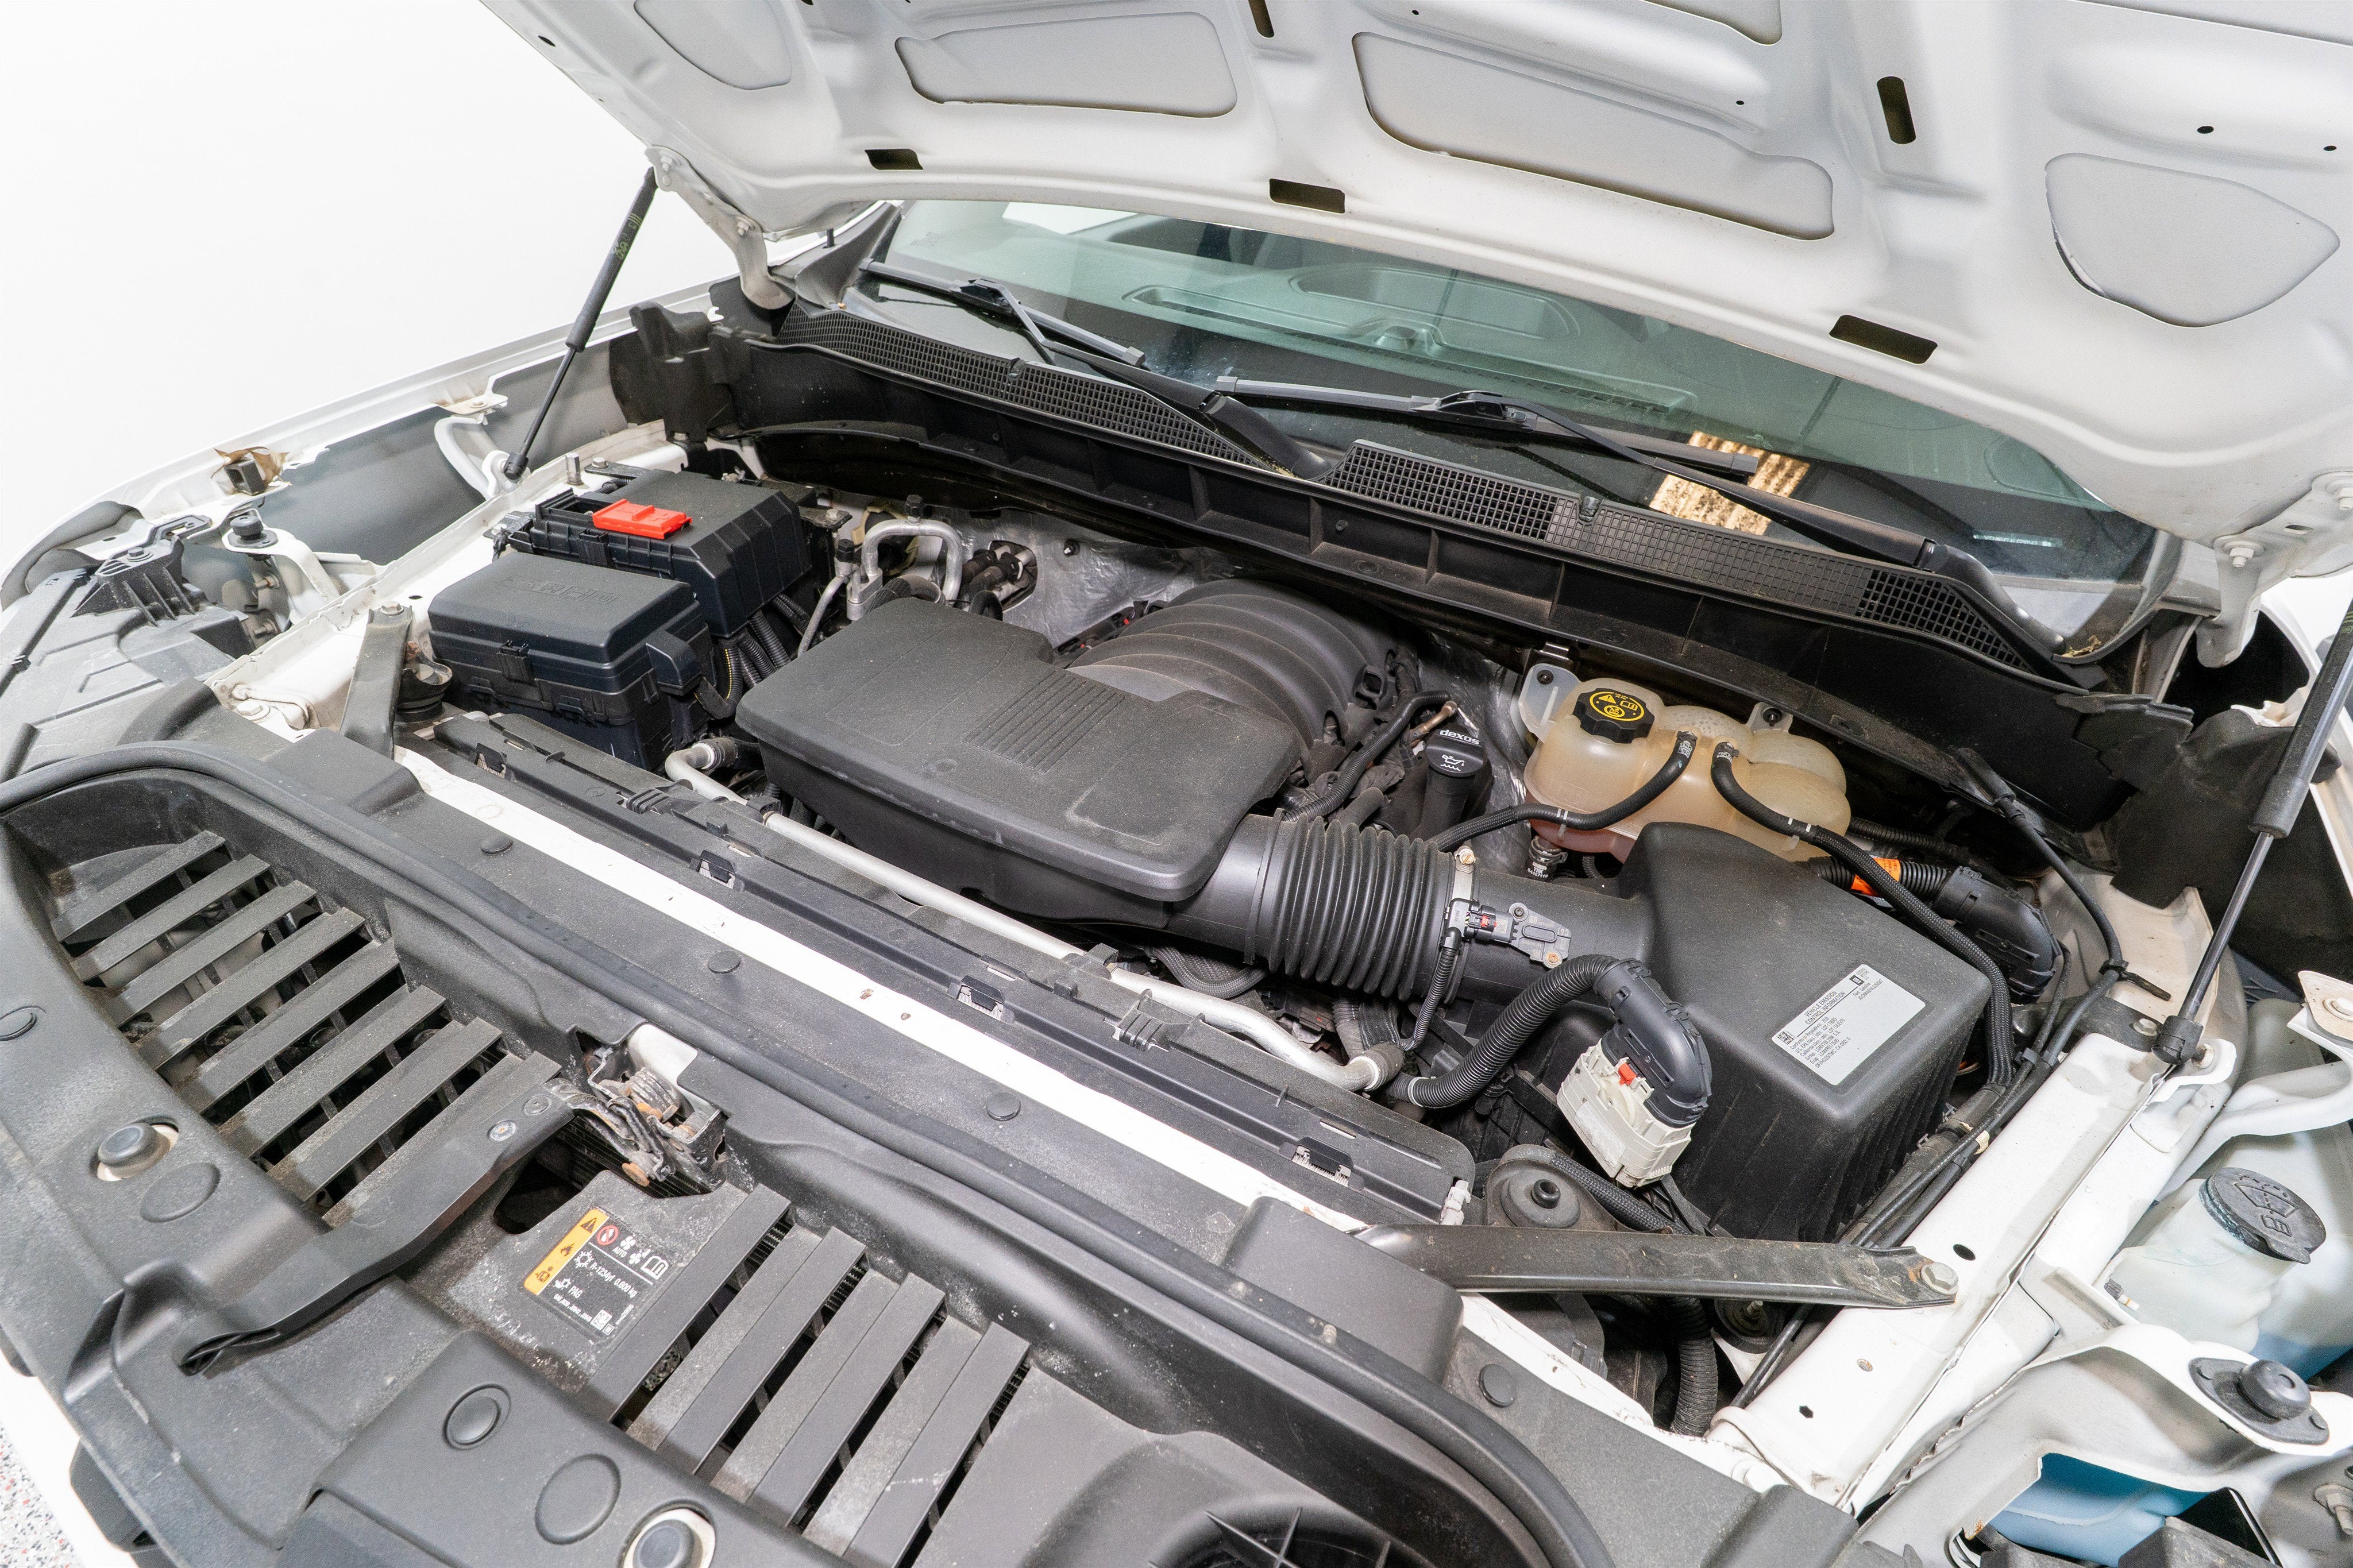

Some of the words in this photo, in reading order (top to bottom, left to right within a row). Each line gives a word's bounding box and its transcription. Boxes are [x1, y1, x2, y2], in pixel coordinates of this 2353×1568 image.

[1440, 729, 1480, 745] dexos
[1804, 1003, 1822, 1017] VEHICLE
[1818, 990, 1837, 1005] EMISSION
[1805, 1010, 1824, 1025] CONTROL
[1820, 991, 1846, 1011] INFORMATION
[1789, 1038, 1804, 1049] Conforms
[612, 1246, 627, 1258] AUTO
[589, 1261, 615, 1282] R-1234yf
[614, 1278, 630, 1292] 0.600
[626, 1287, 638, 1299] kg
[568, 1285, 584, 1299] PAG
